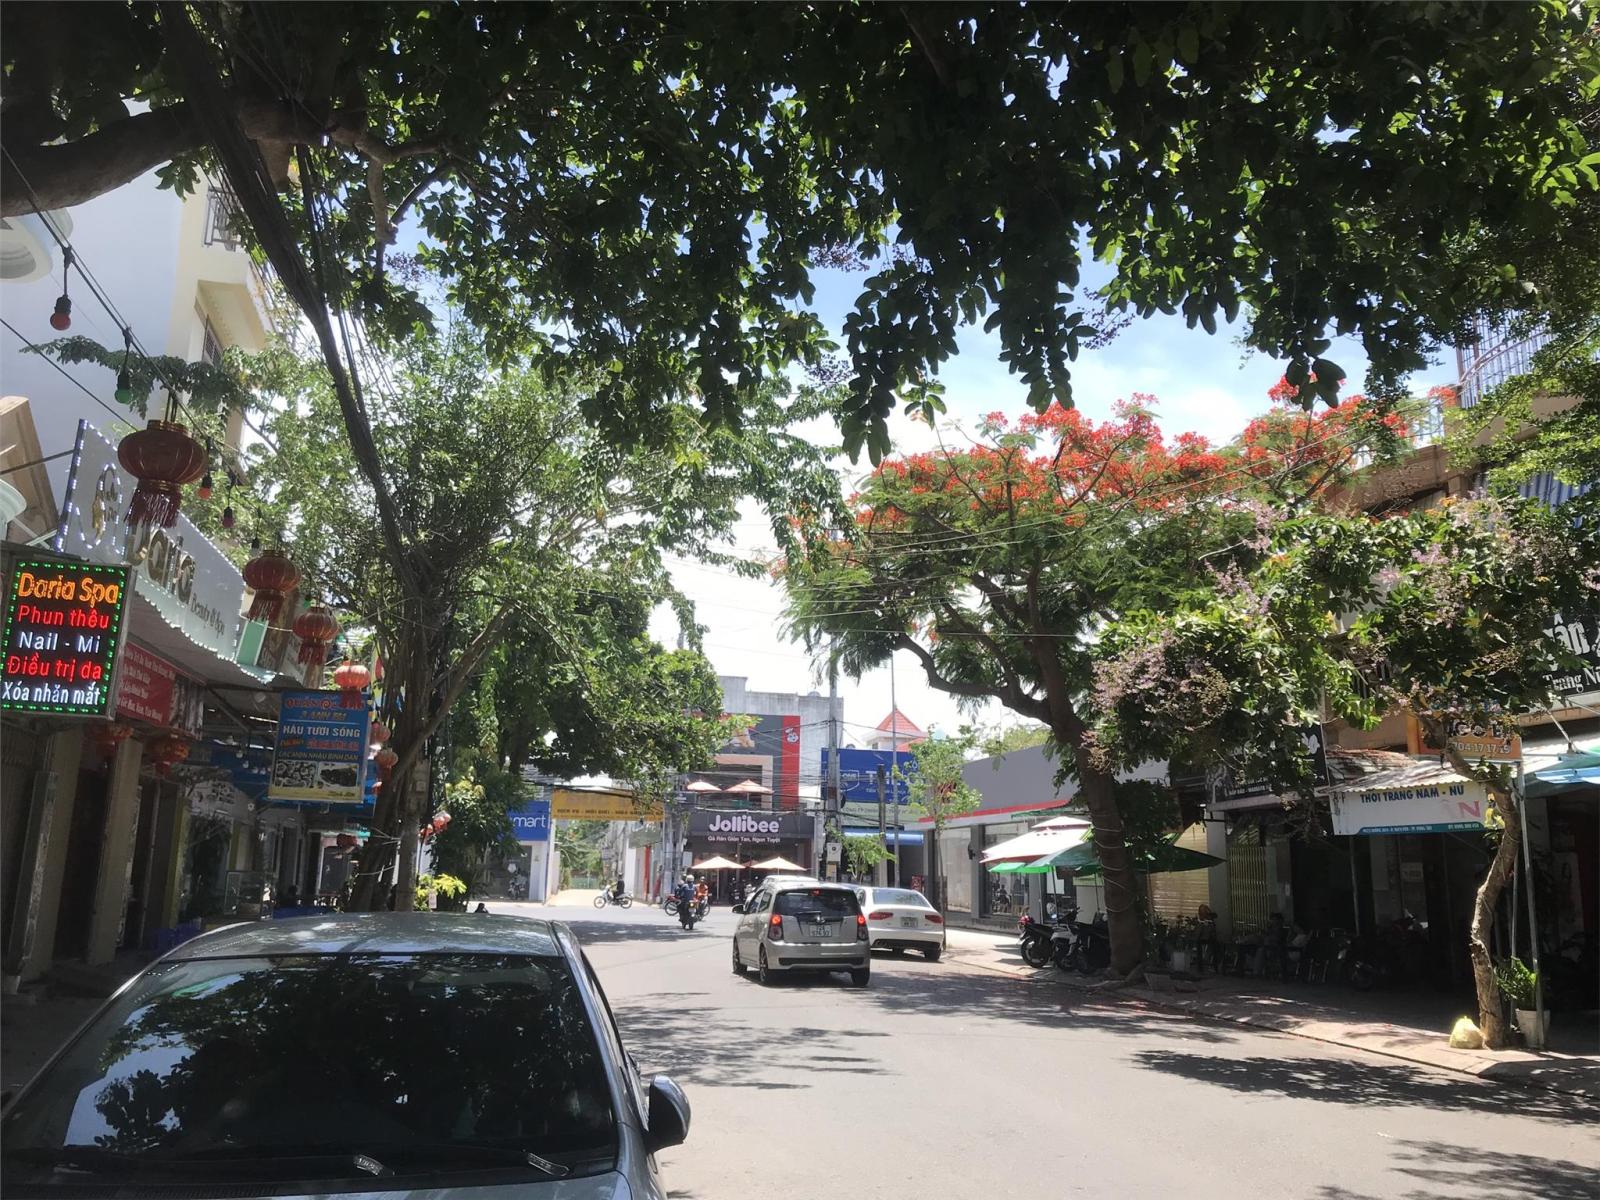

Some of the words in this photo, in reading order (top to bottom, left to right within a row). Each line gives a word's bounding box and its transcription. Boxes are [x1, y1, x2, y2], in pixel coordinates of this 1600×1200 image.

[18, 572, 76, 600] Daria
[79, 577, 119, 608] Spa
[18, 604, 64, 626] Phun
[70, 608, 110, 630] thêu
[18, 631, 59, 651] Nail
[77, 635, 101, 654] Mi
[6, 652, 50, 676] Điều
[56, 658, 77, 682] trị
[80, 661, 102, 680] da
[2, 680, 29, 701] Xóa
[34, 682, 69, 704] nhăn
[72, 681, 101, 705] mắt
[1383, 789, 1414, 802] TRANG
[1415, 787, 1440, 800] NAM
[709, 814, 780, 833] Jollibee
